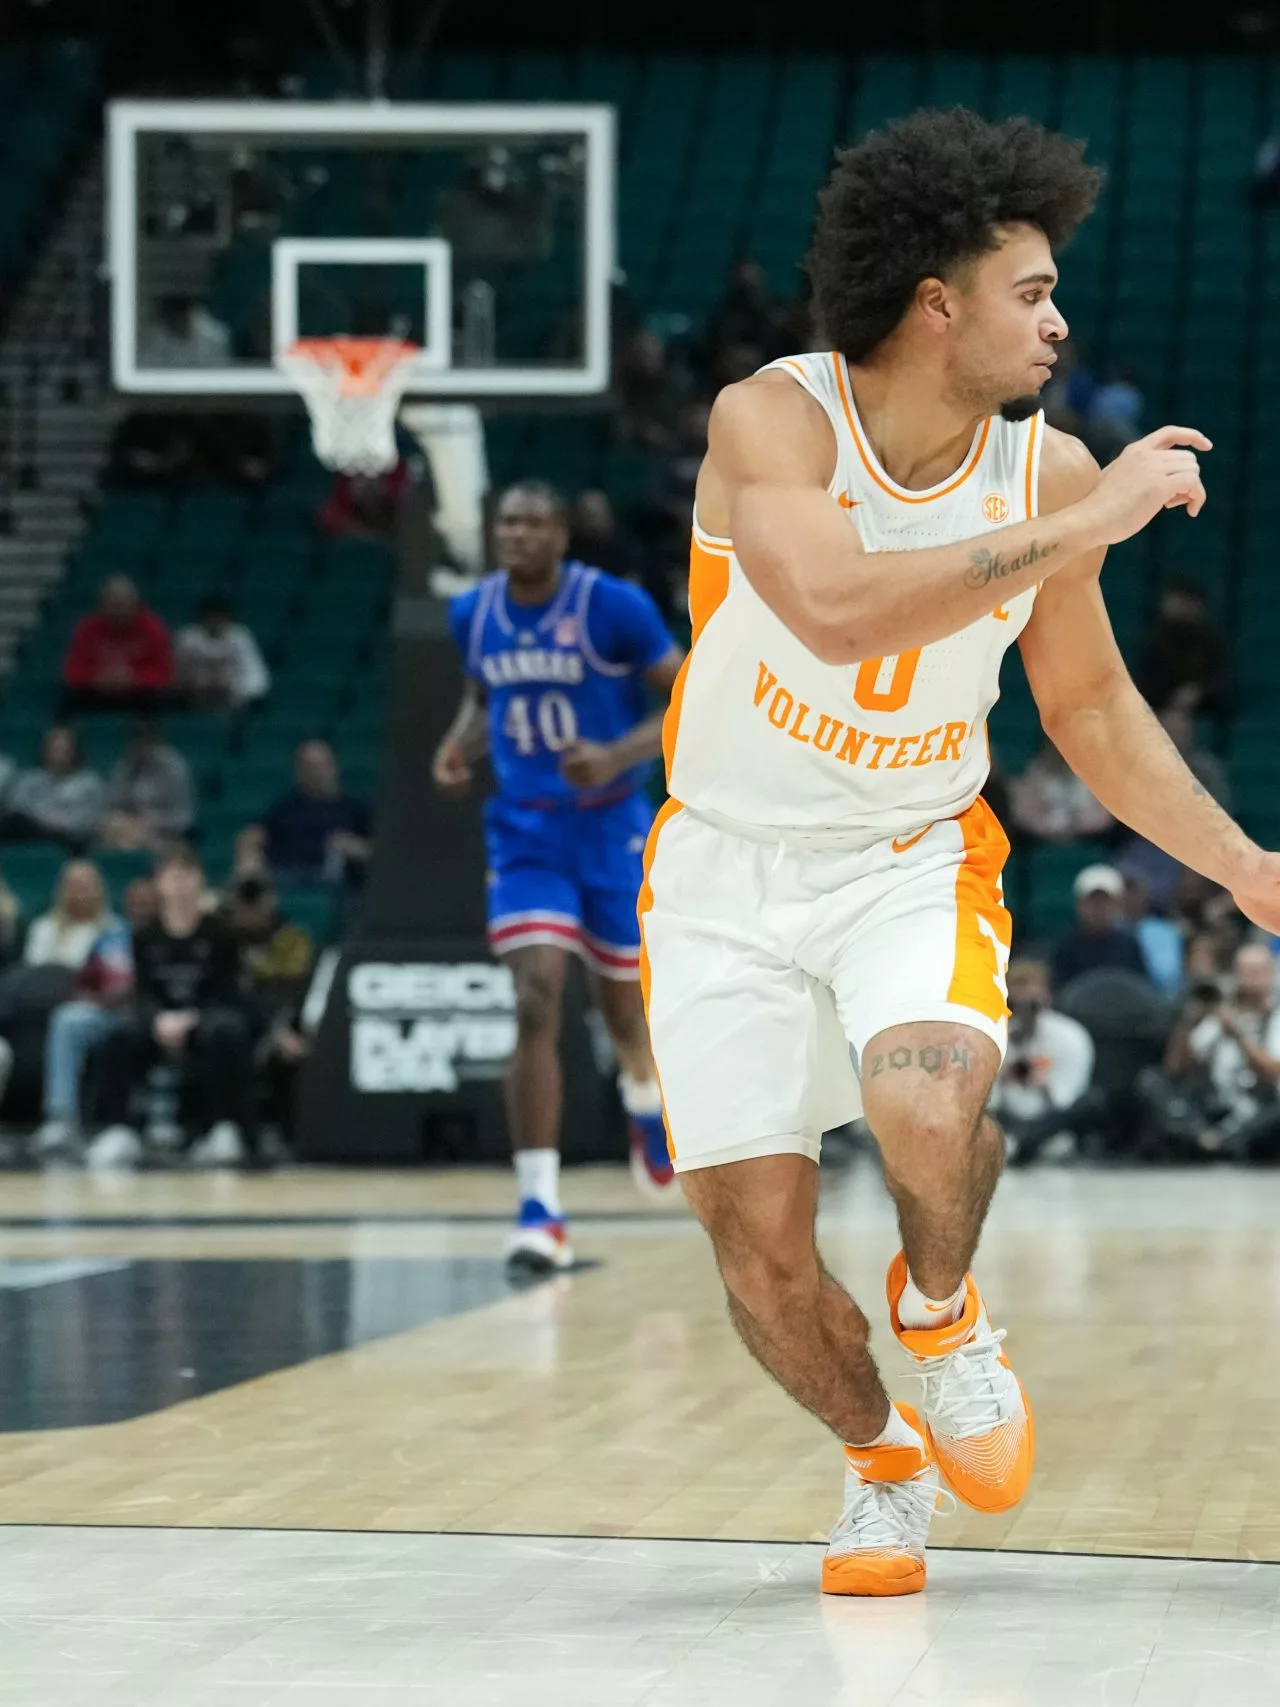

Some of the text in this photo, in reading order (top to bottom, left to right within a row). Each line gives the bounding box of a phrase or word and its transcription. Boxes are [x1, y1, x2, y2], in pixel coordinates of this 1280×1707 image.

[985, 496, 1006, 520] SEC
[964, 539, 1060, 590] Heather
[505, 691, 577, 755] 40
[753, 660, 975, 769] VOLUNTEER
[871, 1045, 969, 1078] 2004
